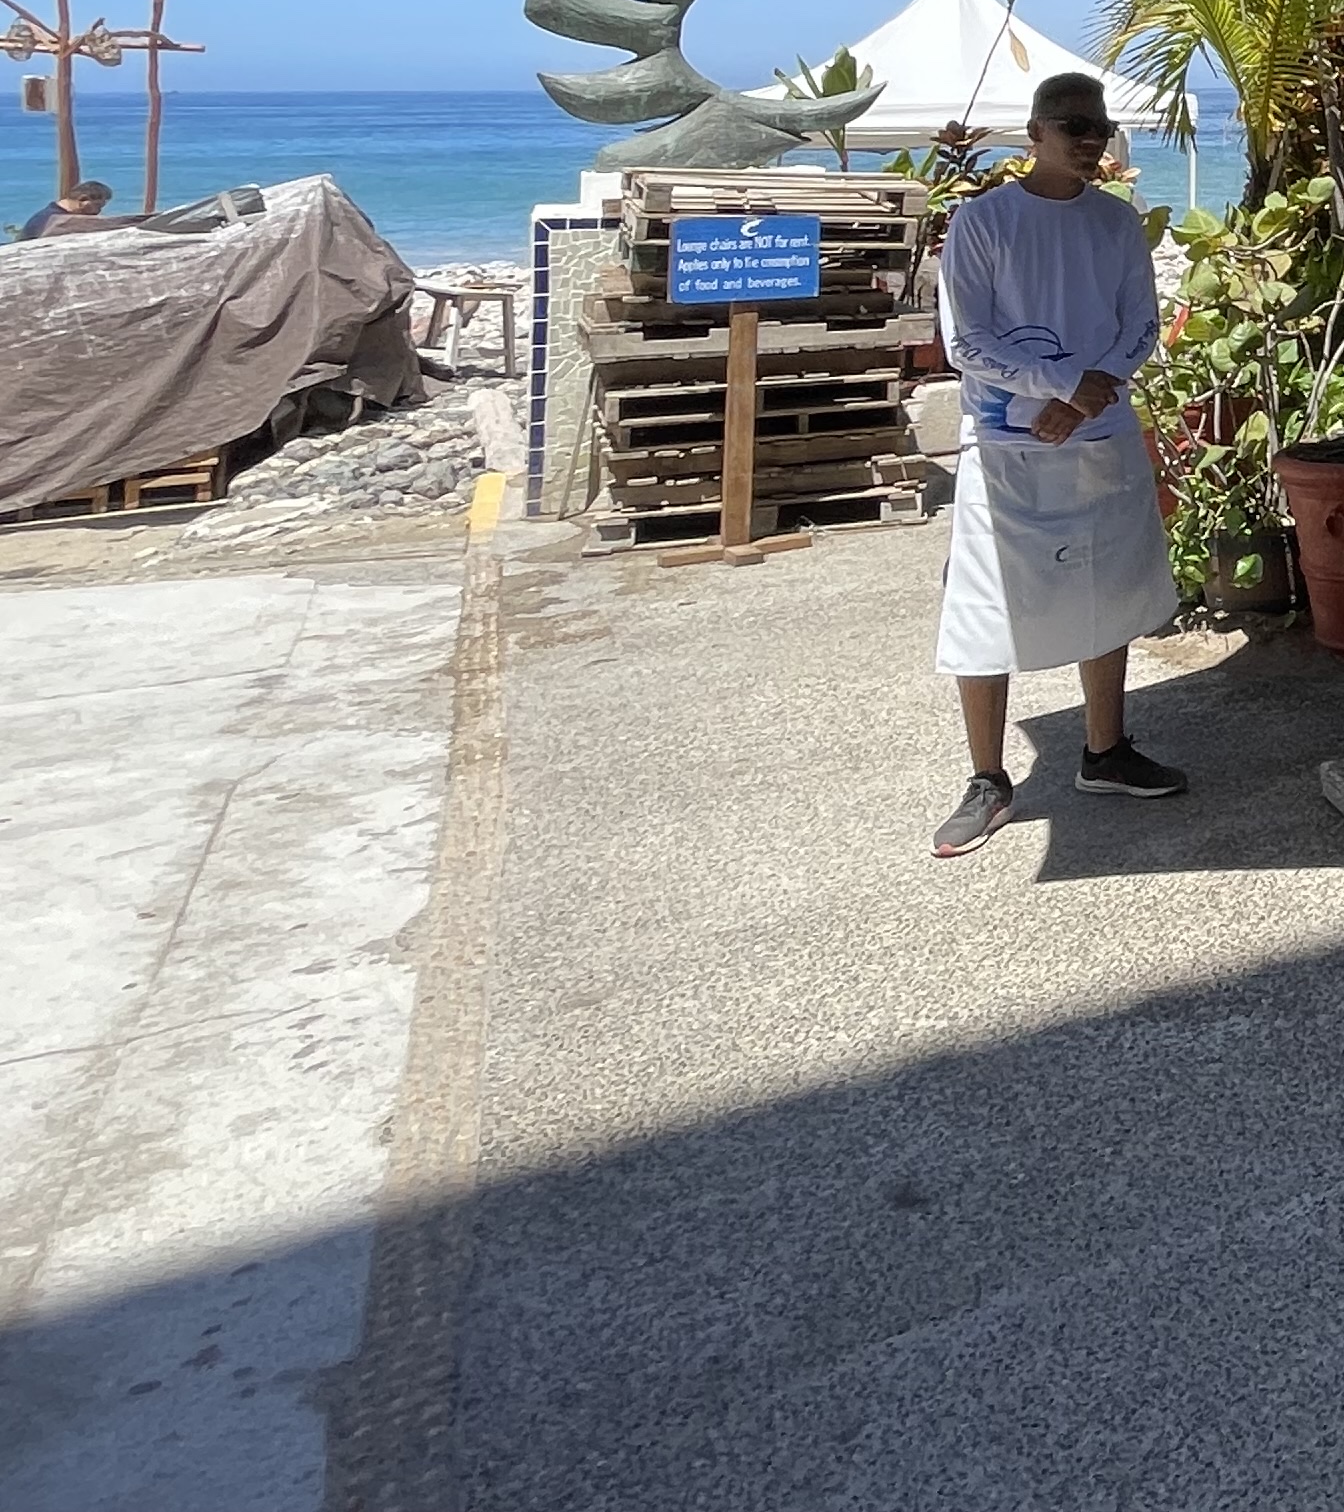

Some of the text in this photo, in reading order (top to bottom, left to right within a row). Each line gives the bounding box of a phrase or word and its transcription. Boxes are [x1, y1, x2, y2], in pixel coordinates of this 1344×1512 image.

[709, 238, 737, 251] chairs
[738, 240, 753, 250] are
[754, 235, 774, 248] NOT
[774, 235, 789, 248] for
[677, 258, 709, 273] Applies
[711, 257, 732, 272] only
[733, 257, 743, 269] to
[679, 280, 692, 292] of
[695, 278, 718, 291] food
[722, 277, 742, 290] and
